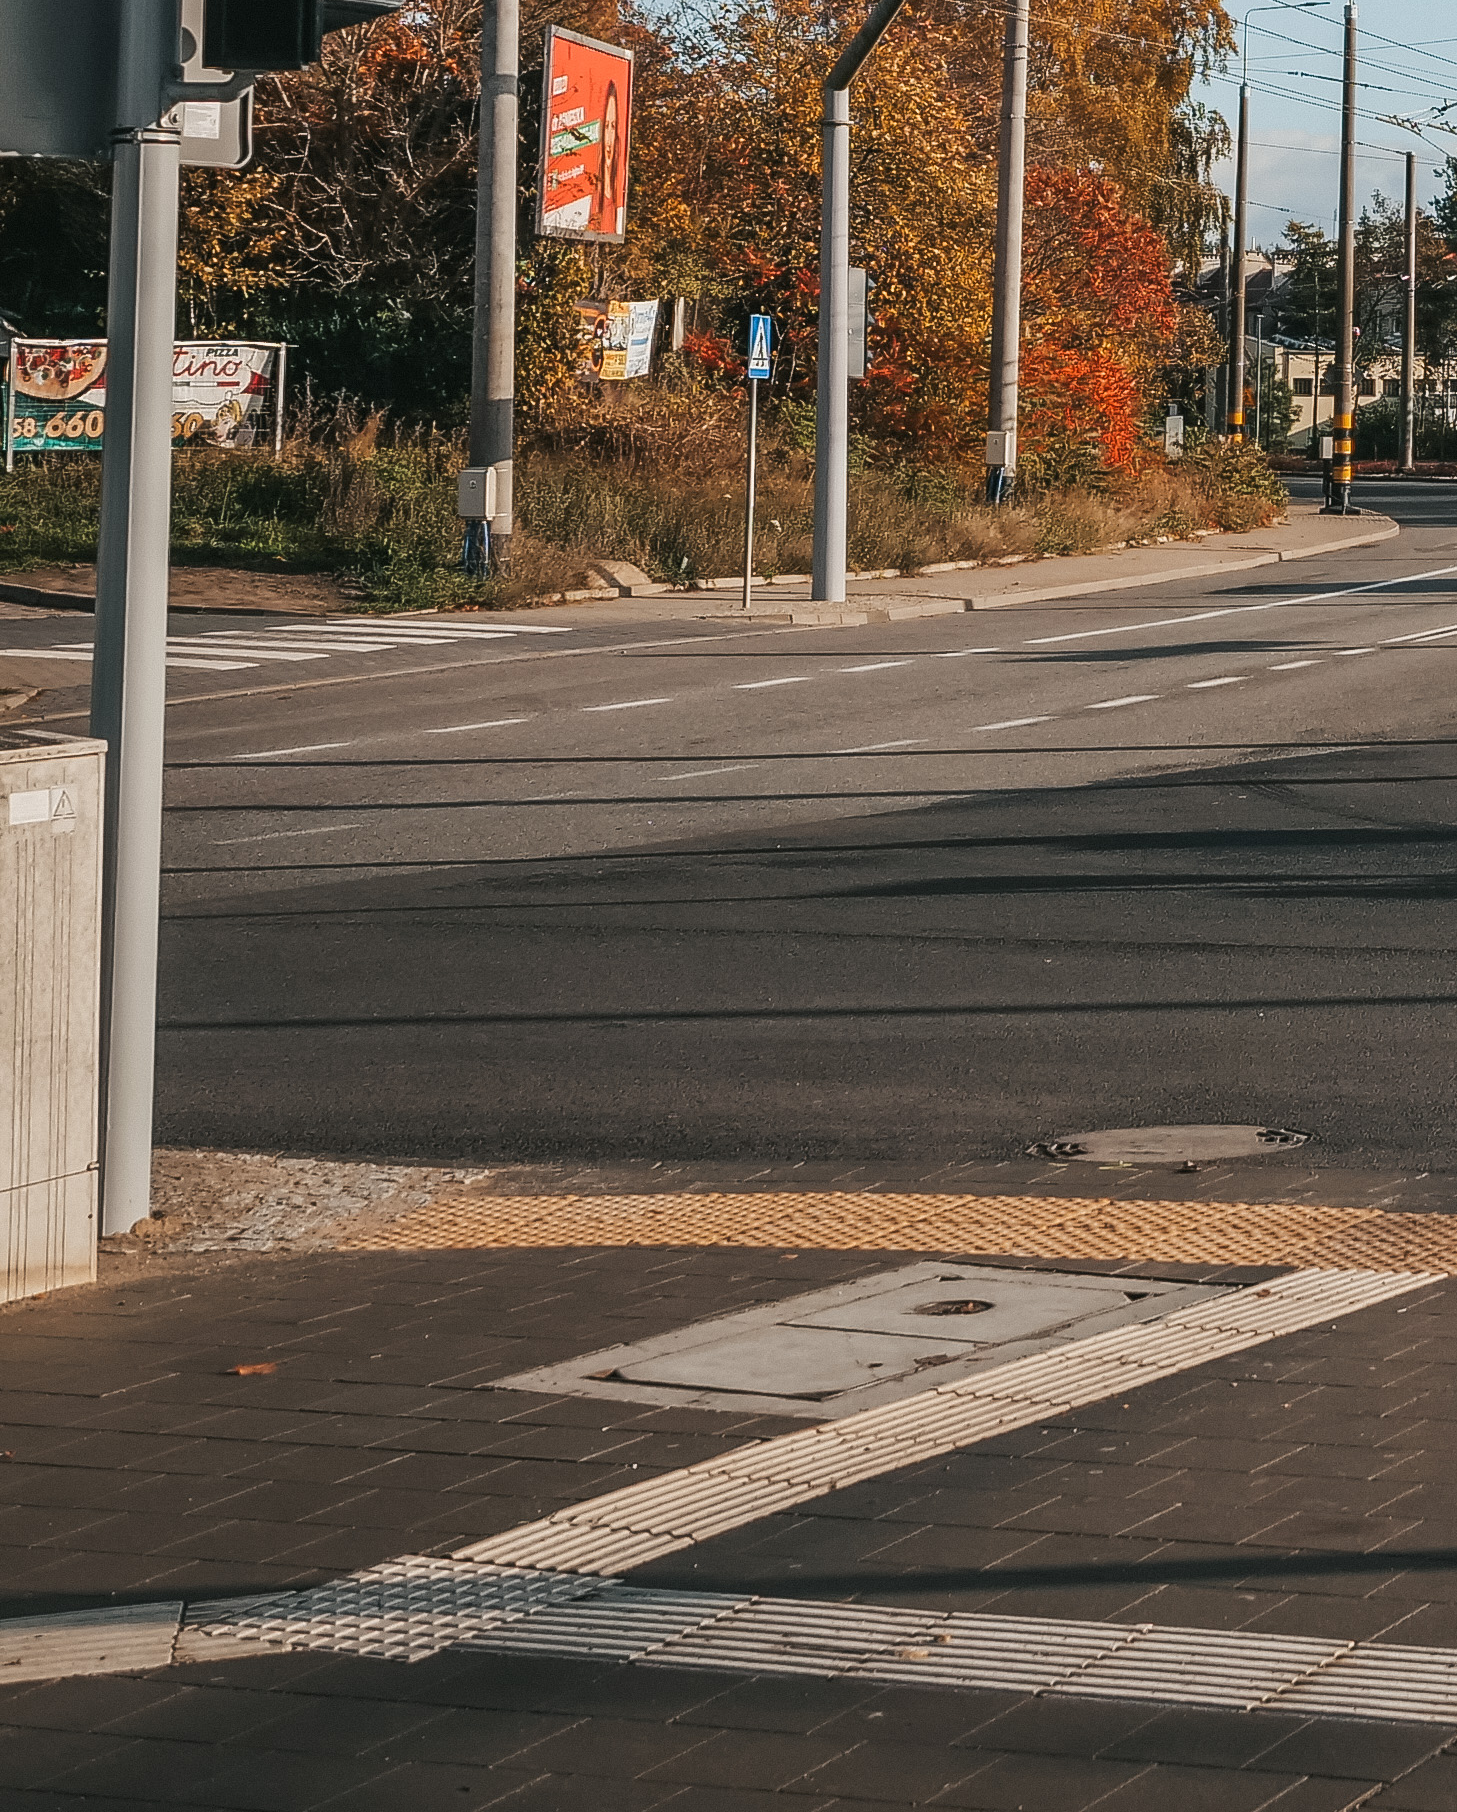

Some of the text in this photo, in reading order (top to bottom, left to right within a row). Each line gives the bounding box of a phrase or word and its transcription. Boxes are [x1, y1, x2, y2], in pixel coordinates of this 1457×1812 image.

[172, 347, 243, 377] tino
[206, 348, 239, 357] PIZZA
[45, 410, 105, 438] 660
